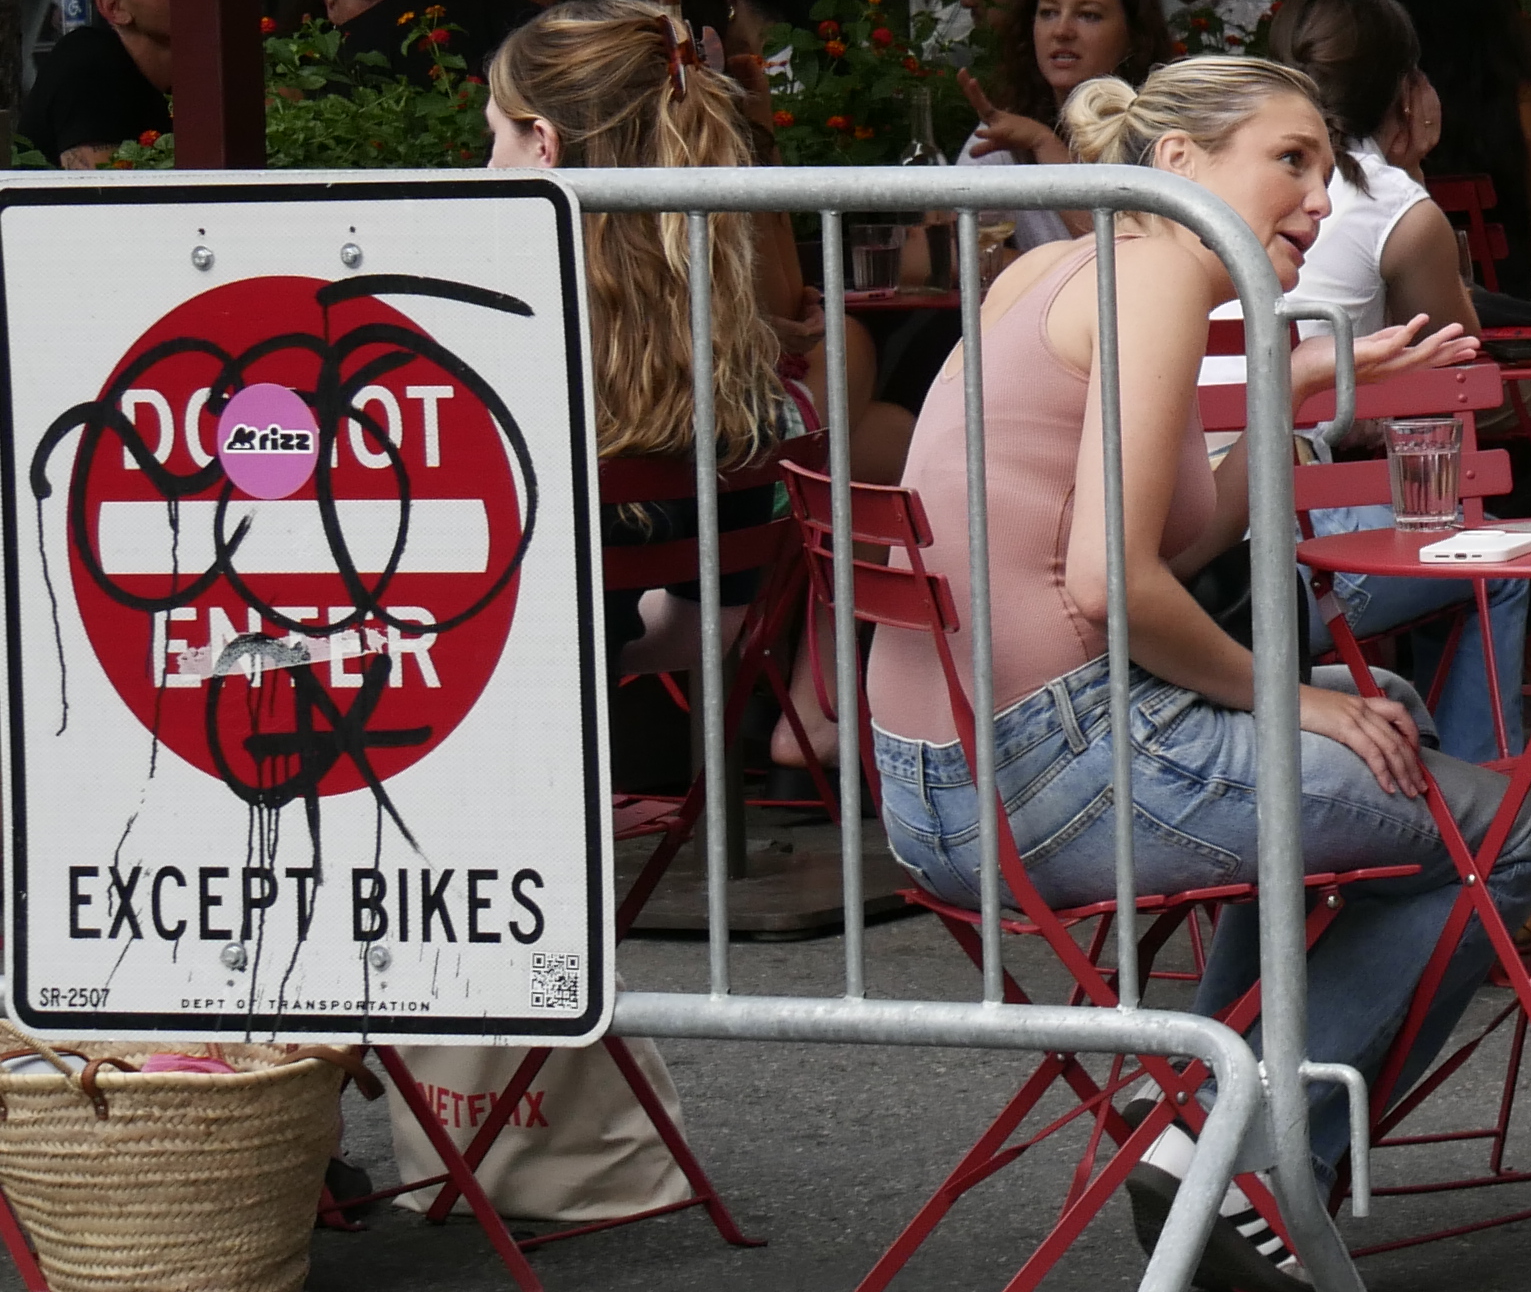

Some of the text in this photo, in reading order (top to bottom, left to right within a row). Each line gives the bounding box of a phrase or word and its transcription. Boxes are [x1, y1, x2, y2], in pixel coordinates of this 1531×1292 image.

[67, 865, 546, 945] EXCEPT BIKES
[38, 987, 111, 1008] SR-2507
[181, 998, 225, 1009] DEPT
[268, 998, 431, 1012] TRANSPORTATION
